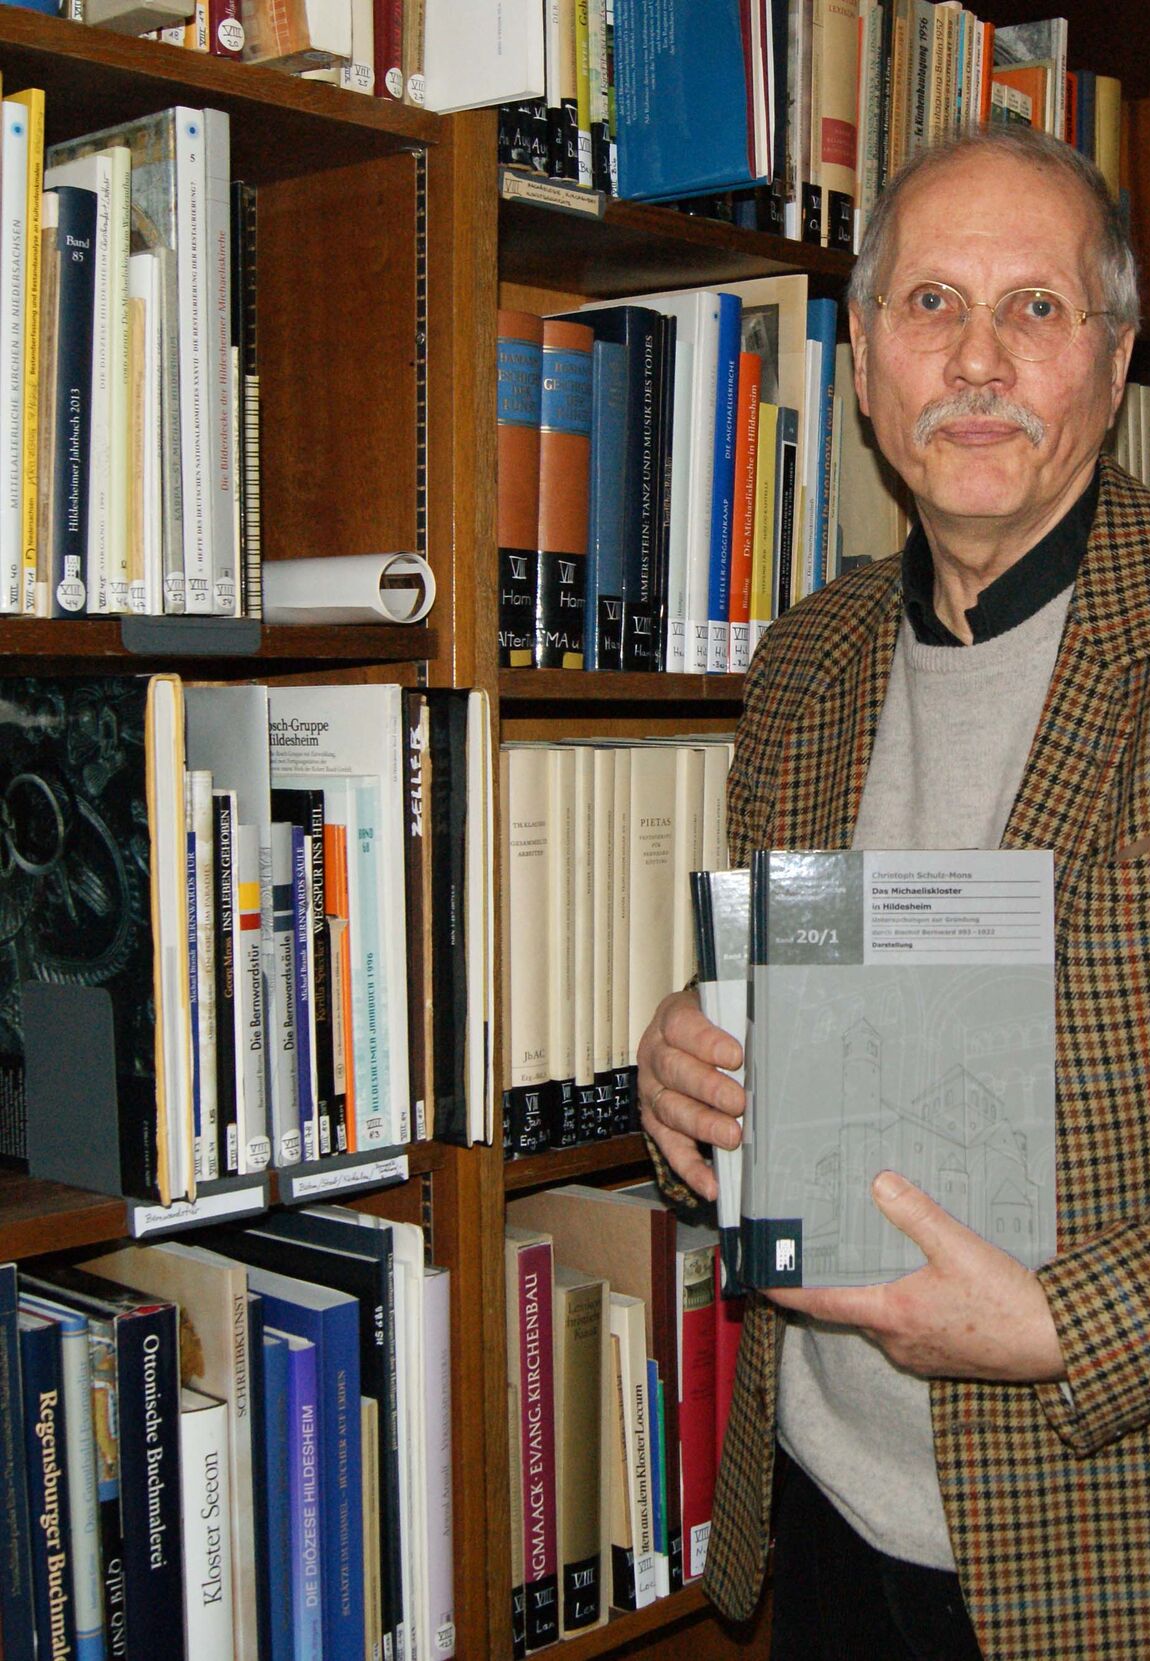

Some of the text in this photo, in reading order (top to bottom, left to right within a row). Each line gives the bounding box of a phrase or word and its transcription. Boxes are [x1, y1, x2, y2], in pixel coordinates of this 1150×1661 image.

[35, 223, 38, 233] an
[122, 170, 130, 230] Wiederaufbau
[65, 236, 91, 249] Band
[71, 250, 85, 263] 85
[122, 242, 130, 307] Michaeliskirche
[121, 309, 129, 325] Die
[11, 218, 21, 509] MITTELALTERLICHE KIRCHEN IN NIEDERSACHSEN
[218, 230, 229, 492] Die Bilderdecke der Hildesheimer Michaeliskirche
[749, 384, 758, 443] Hildesheim
[69, 388, 80, 532] Hildesheimer Jahrbuch 2013
[747, 444, 754, 455] in
[720, 498, 728, 610] BESELER/ROGGENKAMP
[727, 360, 735, 442] MICHAELISKIRCHE
[745, 457, 754, 537] Michaeliskirche
[502, 588, 533, 606] Ham
[742, 578, 750, 609] Binding
[411, 723, 422, 838] ZELLER
[313, 805, 322, 838] HEIL
[640, 816, 672, 828] PIETAS
[314, 842, 322, 864] INS
[871, 871, 973, 881] Christoph Schulz-Mons
[188, 876, 196, 943] BERNWARDS
[221, 809, 234, 998] Georg Mross INS LEBEN GEHOBEN
[314, 868, 324, 934] WEGSPUR
[871, 887, 963, 896] Das Michaeliskloster
[872, 902, 932, 911] in Hildesheim
[796, 929, 840, 946] 20/1
[871, 941, 914, 951] Darstellung
[248, 943, 262, 1051] Die Bernwardstür
[280, 935, 295, 1051] Die Bernwardssäule
[367, 952, 379, 1112] HILDESHEIMER JAHRBUCH 1996
[523, 1048, 546, 1063] JbAC
[235, 1295, 246, 1420] SCHREIBKUNST
[525, 1271, 541, 1400] KIRCHENBAU
[336, 1370, 346, 1410] ERDEN
[634, 1383, 645, 1434] Loccum
[144, 1334, 168, 1570] Ottonische Buchmalerei
[528, 1402, 544, 1472] EVANG.
[636, 1435, 648, 1478] Kloster
[36, 1388, 60, 1551] Regensburger
[638, 1480, 648, 1507] dem
[202, 1452, 222, 1607] Kloster Seeon
[303, 1404, 318, 1607] DIE DIÖZESE HILDESHEIM
